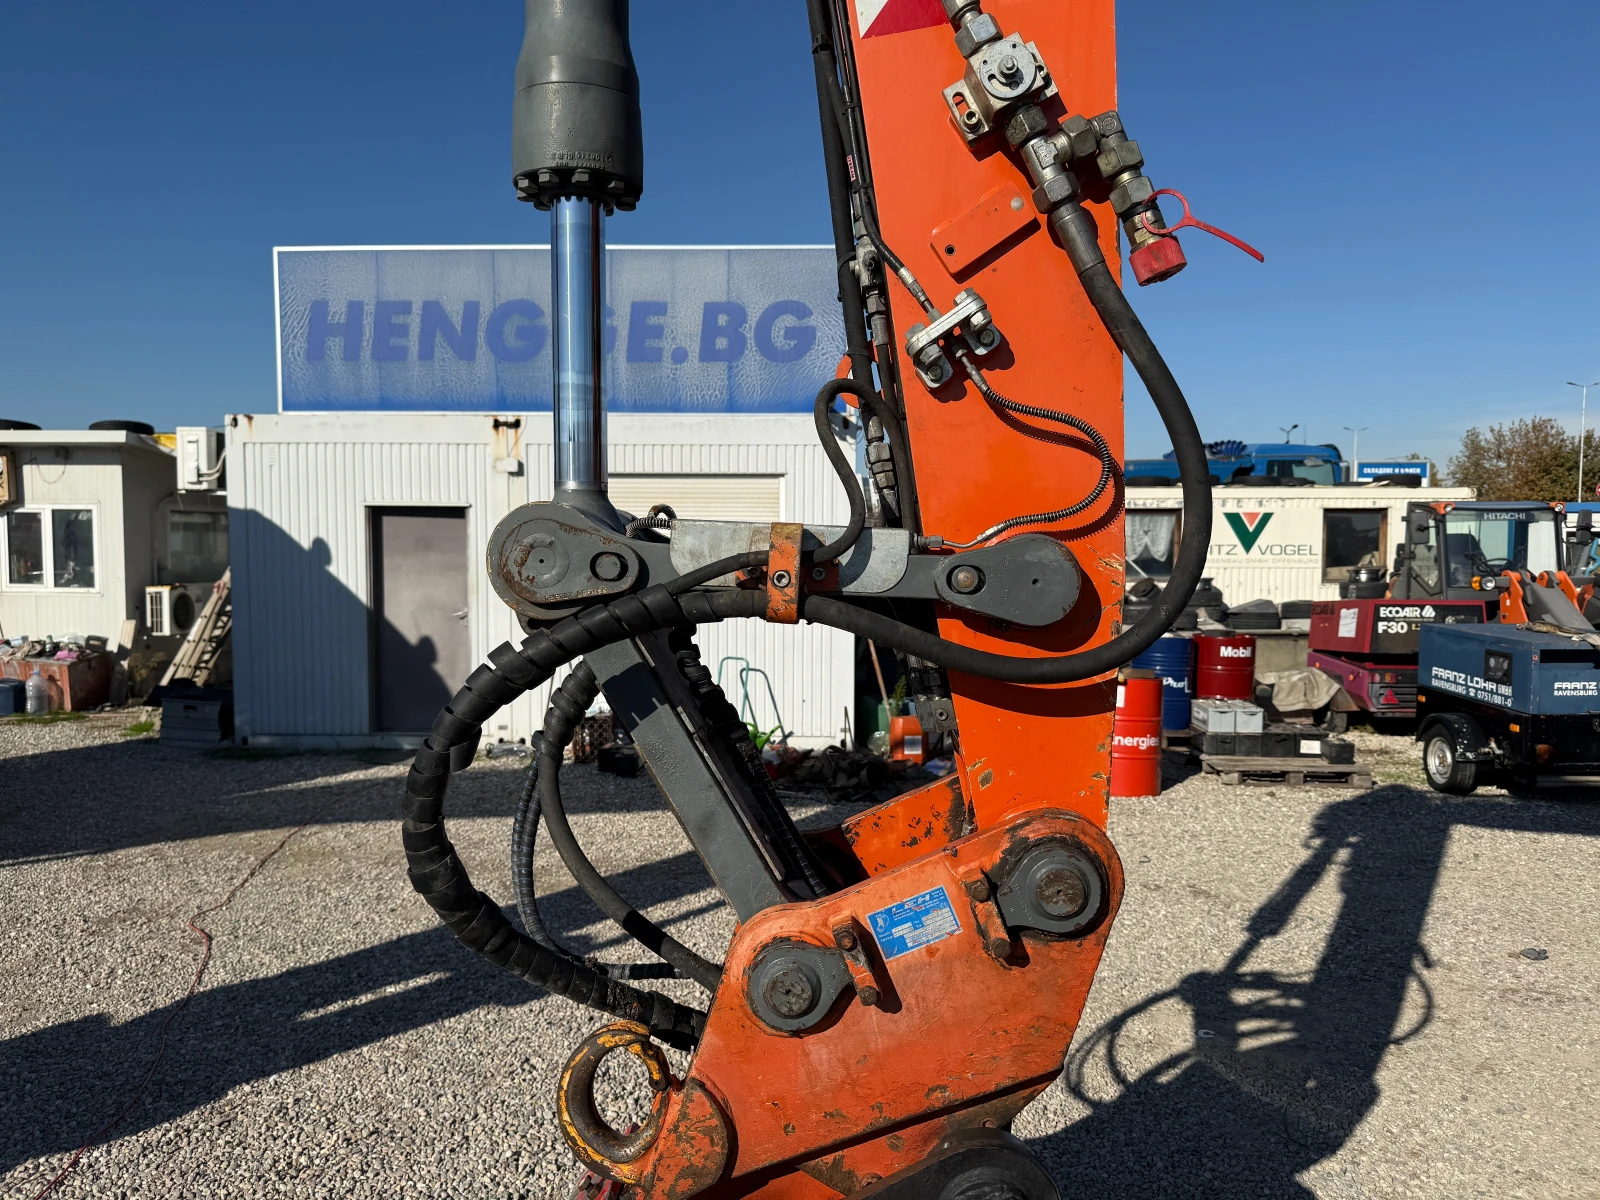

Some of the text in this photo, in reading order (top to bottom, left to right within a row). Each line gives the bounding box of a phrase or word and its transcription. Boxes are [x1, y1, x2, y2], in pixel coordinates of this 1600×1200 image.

[306, 299, 817, 363] HENGE.BG
[1484, 512, 1526, 520] HITACHI
[1209, 544, 1319, 556] ITZ VOGEL
[1271, 557, 1319, 565] OFFENBURG
[1379, 606, 1421, 618] ECOAIR
[1377, 621, 1408, 634] F30
[1220, 646, 1252, 657] Mobil
[1432, 666, 1466, 685] FRANZ
[1467, 674, 1497, 693] LOHR
[1554, 681, 1597, 690] FRANZ
[1431, 678, 1512, 707] RAVENSBURG 0751/881-0
[1112, 733, 1159, 750] nergies
